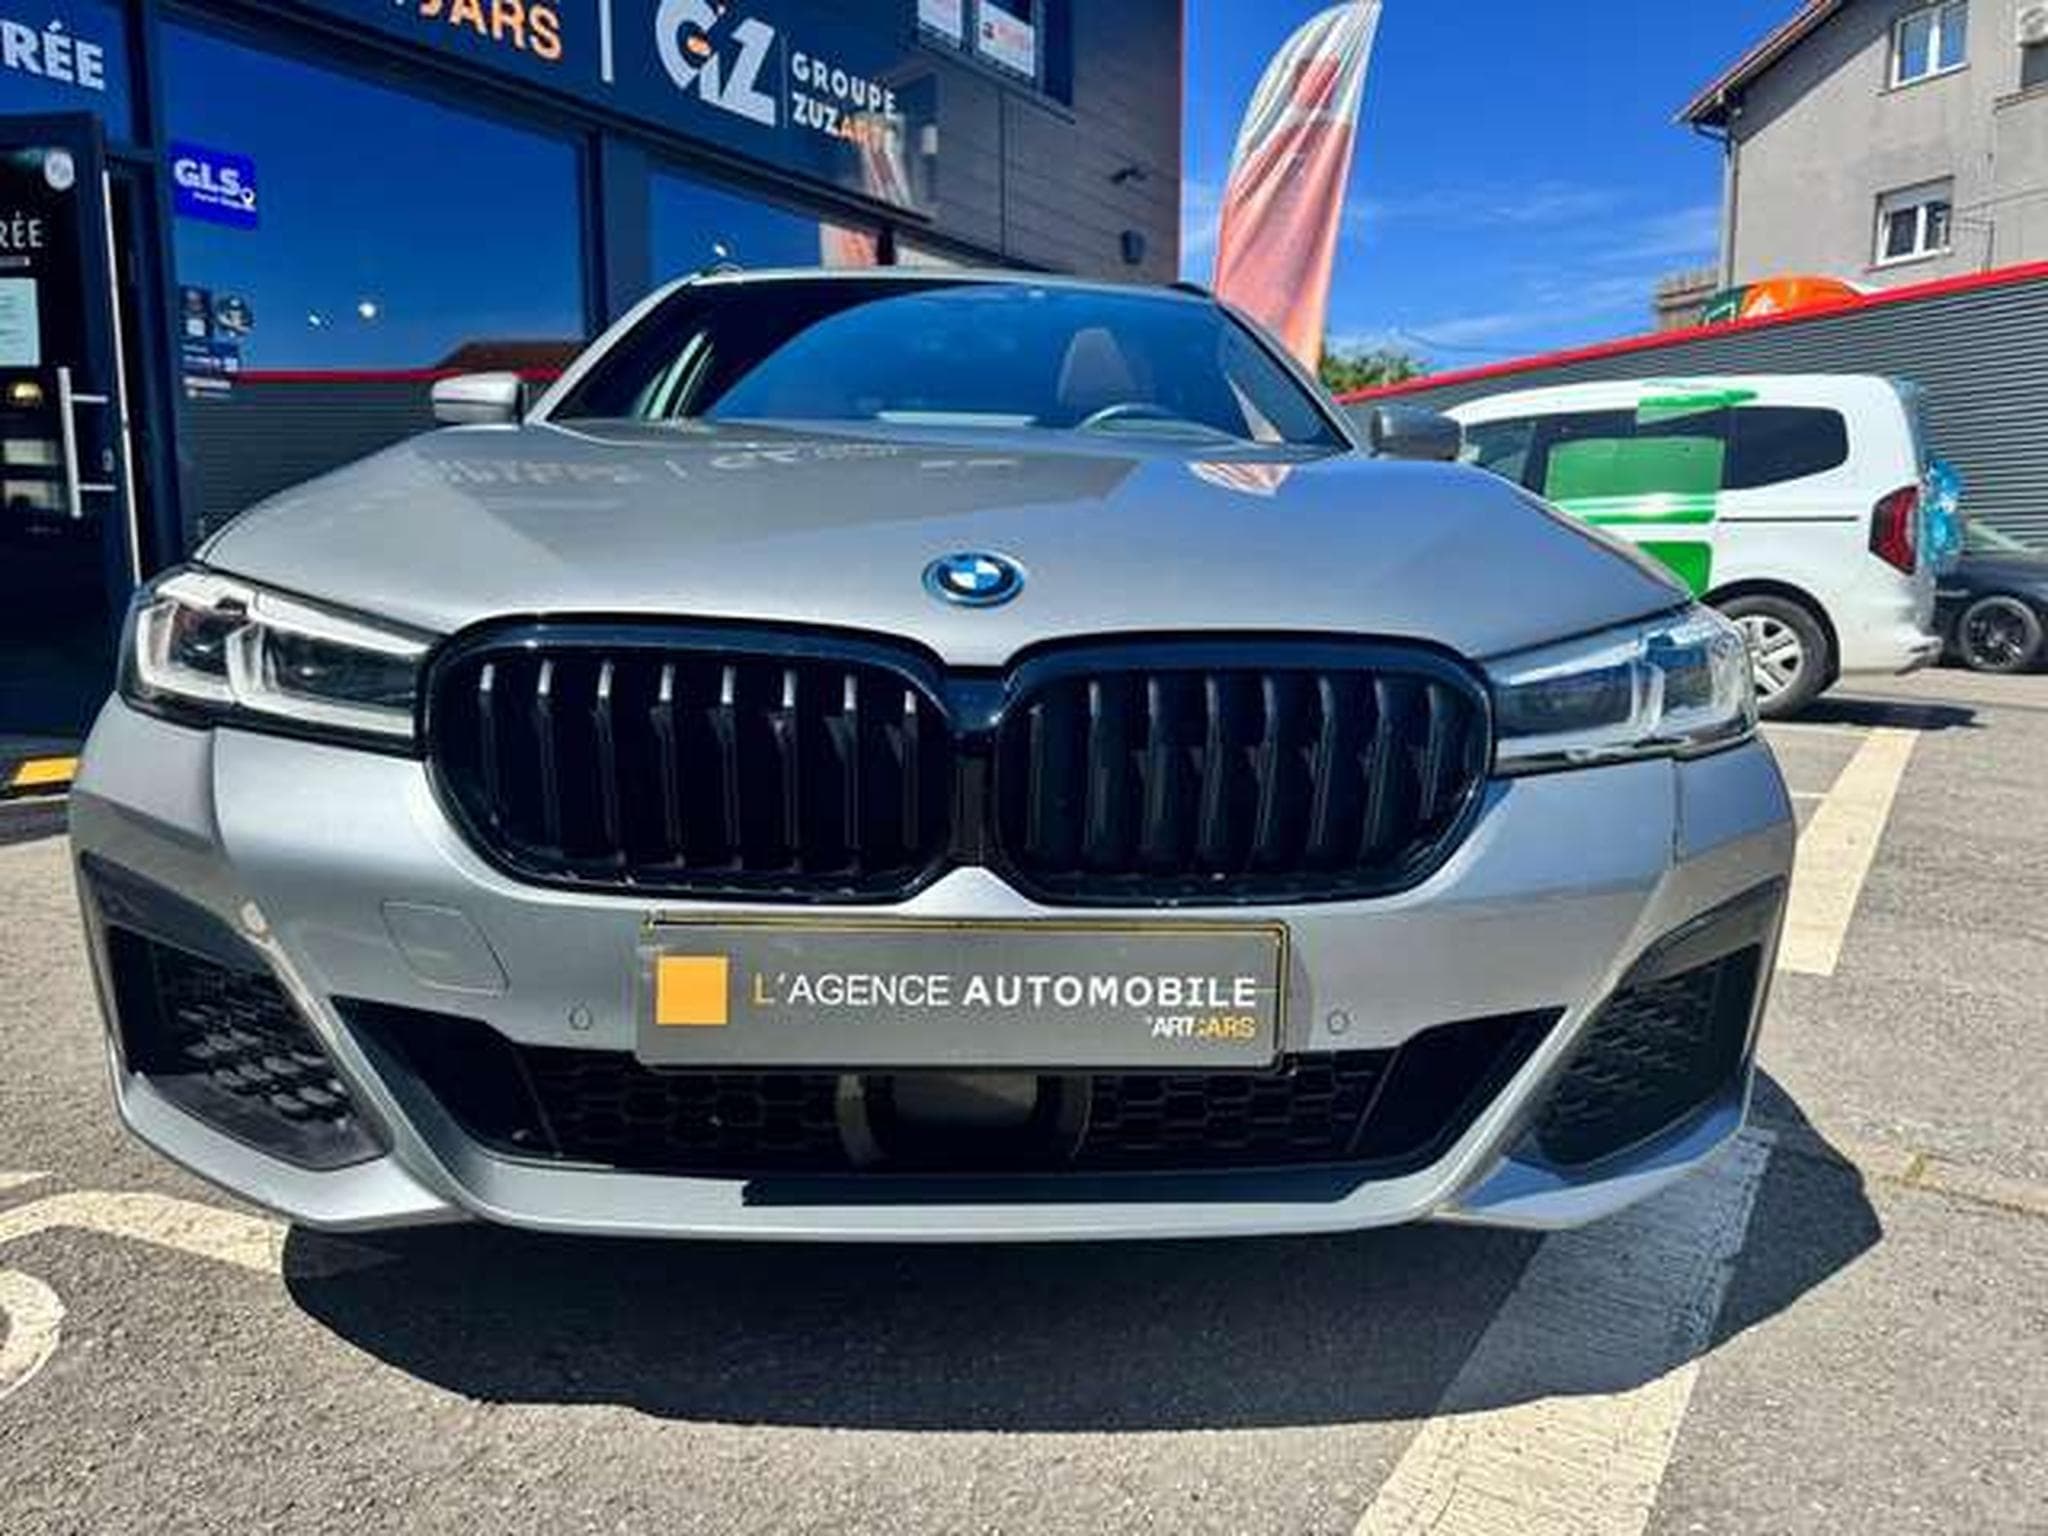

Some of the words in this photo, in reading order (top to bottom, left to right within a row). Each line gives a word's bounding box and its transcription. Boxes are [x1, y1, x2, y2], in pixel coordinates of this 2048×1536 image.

[791, 51, 898, 121] GROUPE
[174, 158, 241, 196] GLS
[754, 972, 950, 1007] L'AGENCE
[962, 974, 1257, 1008] AUTOMOBILE
